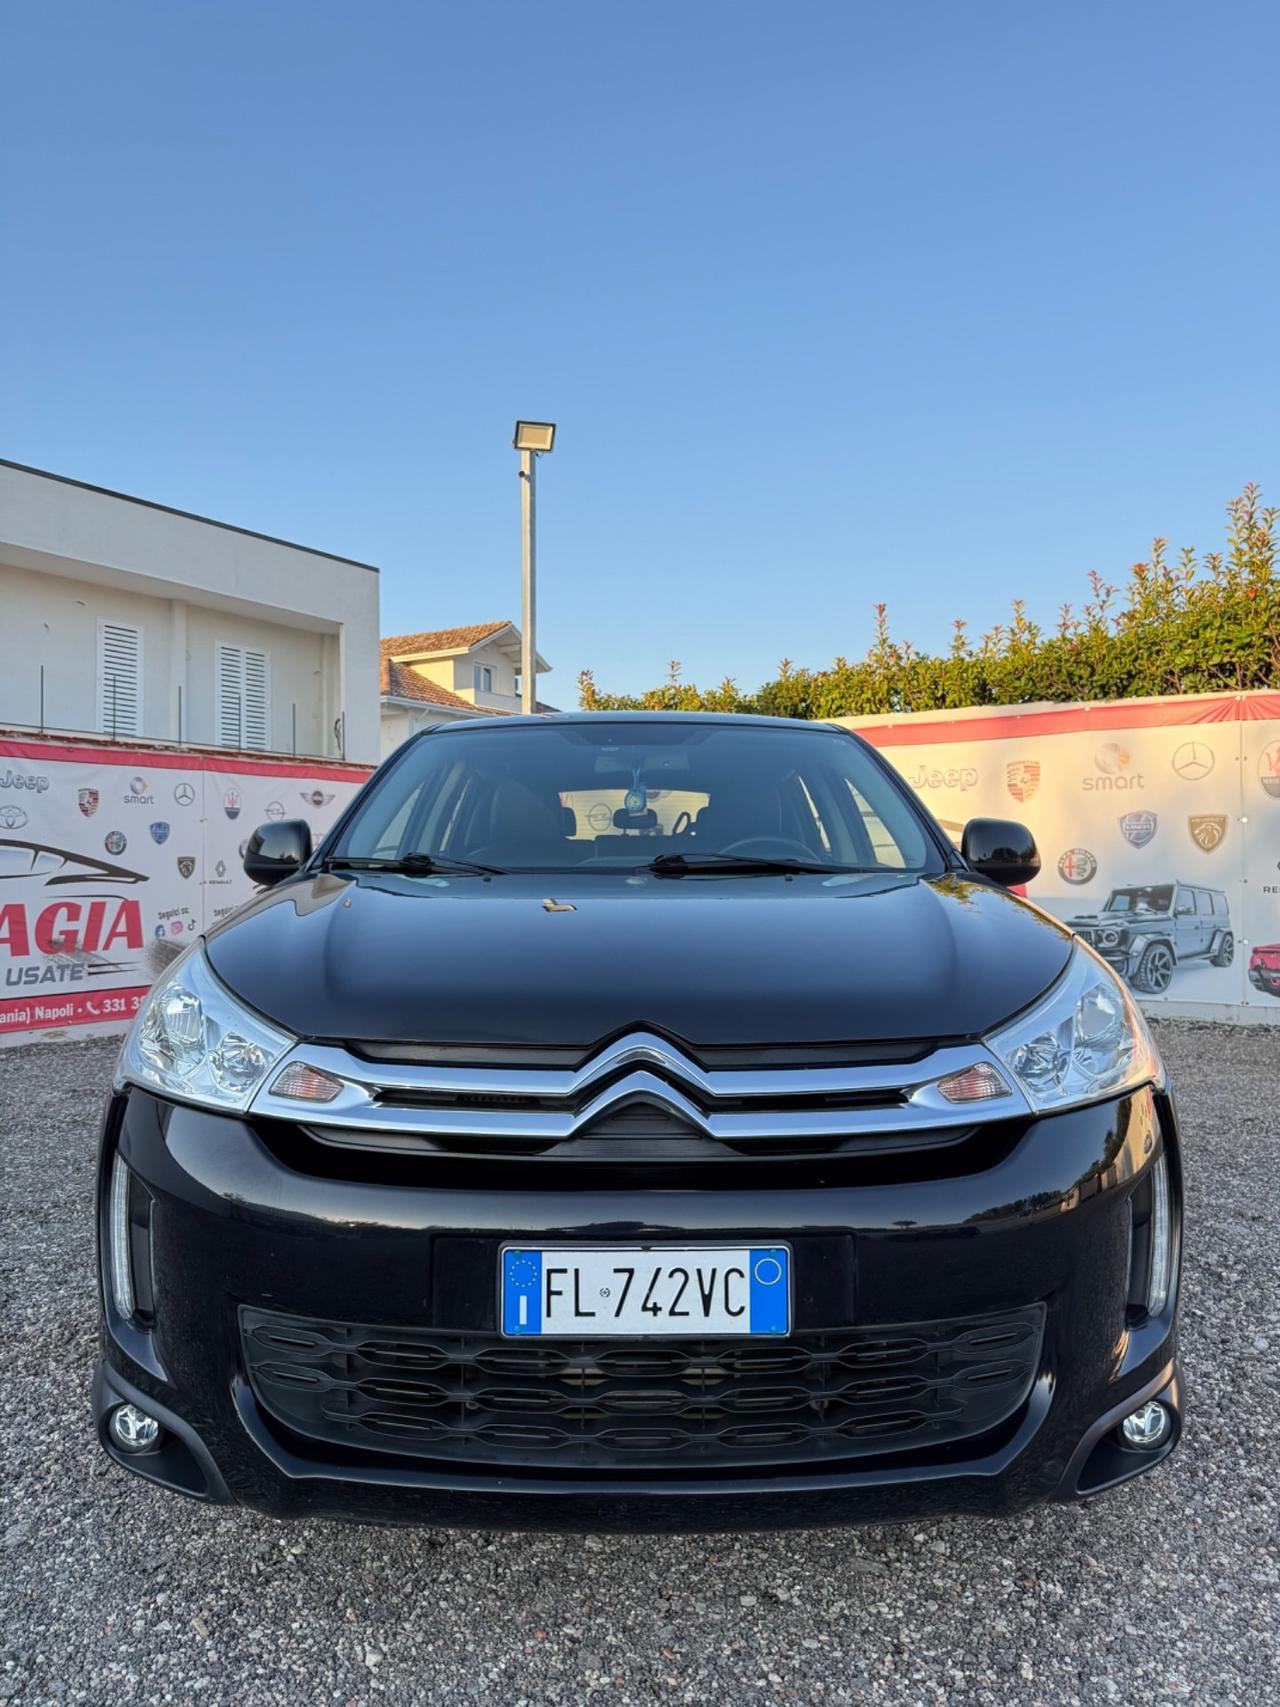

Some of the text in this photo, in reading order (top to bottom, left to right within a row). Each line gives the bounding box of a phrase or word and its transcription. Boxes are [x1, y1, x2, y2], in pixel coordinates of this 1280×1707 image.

[0, 770, 49, 794] Jeep
[908, 764, 979, 792] Jeep
[1082, 773, 1145, 791] smart
[123, 794, 155, 805] smart
[0, 900, 144, 957] AGIA
[5, 962, 84, 986] USATE
[0, 1008, 31, 1024] ania)
[34, 1002, 74, 1020] Napoli
[103, 998, 126, 1013] 331
